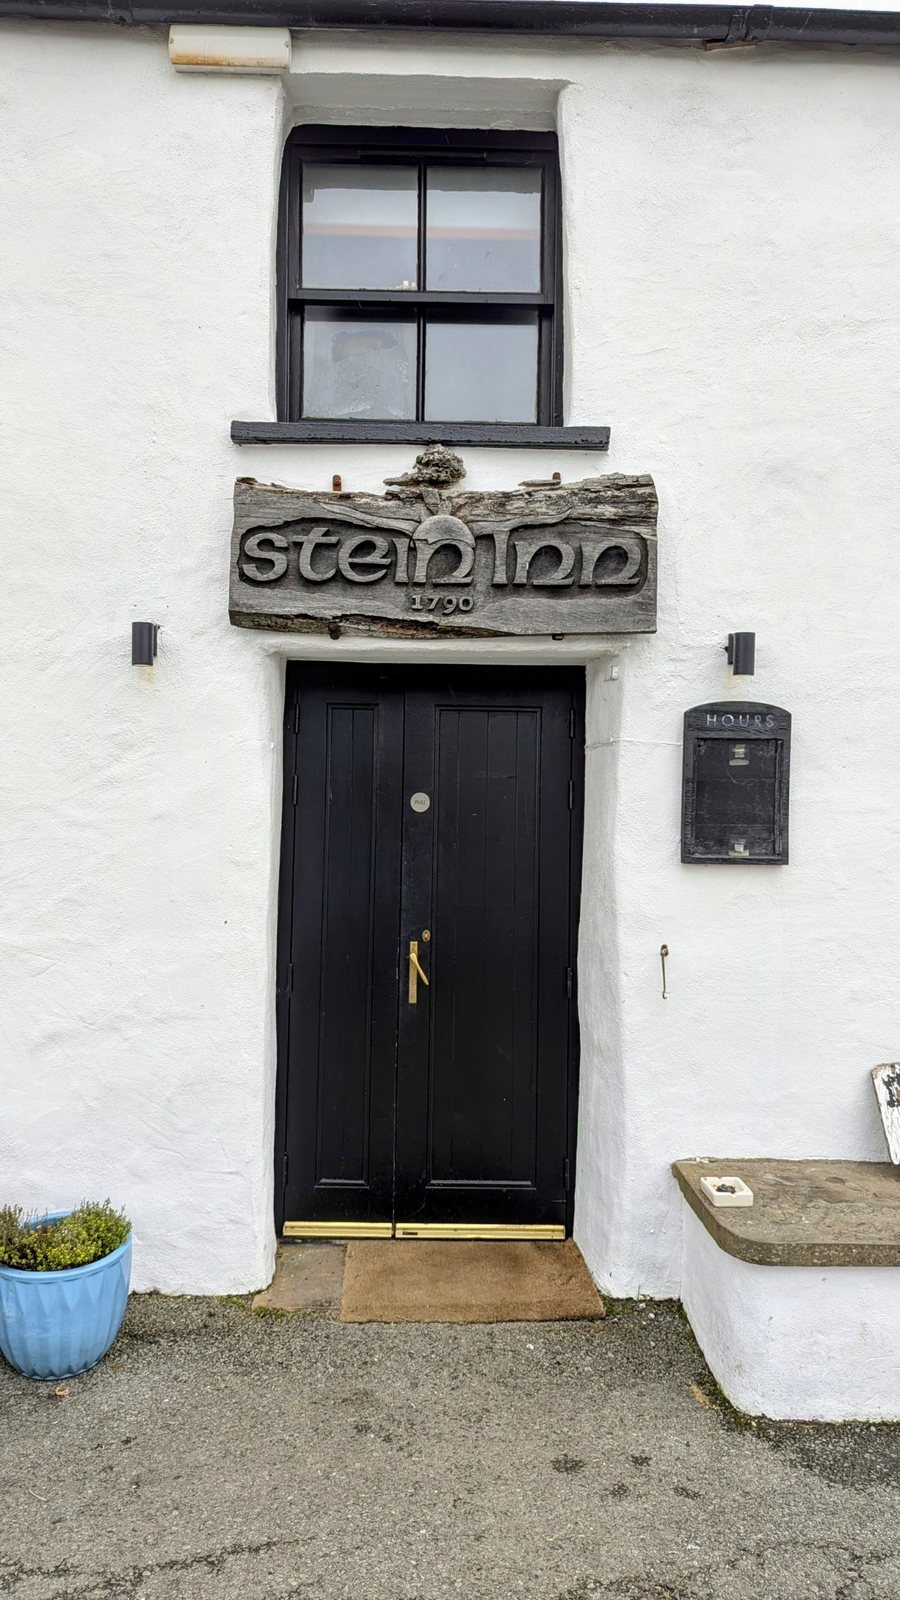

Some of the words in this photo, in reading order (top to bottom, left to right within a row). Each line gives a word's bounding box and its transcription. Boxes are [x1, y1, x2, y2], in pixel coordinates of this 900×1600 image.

[492, 530, 641, 585] Inn
[411, 594, 474, 615] 1790
[706, 714, 775, 728] HOURS
